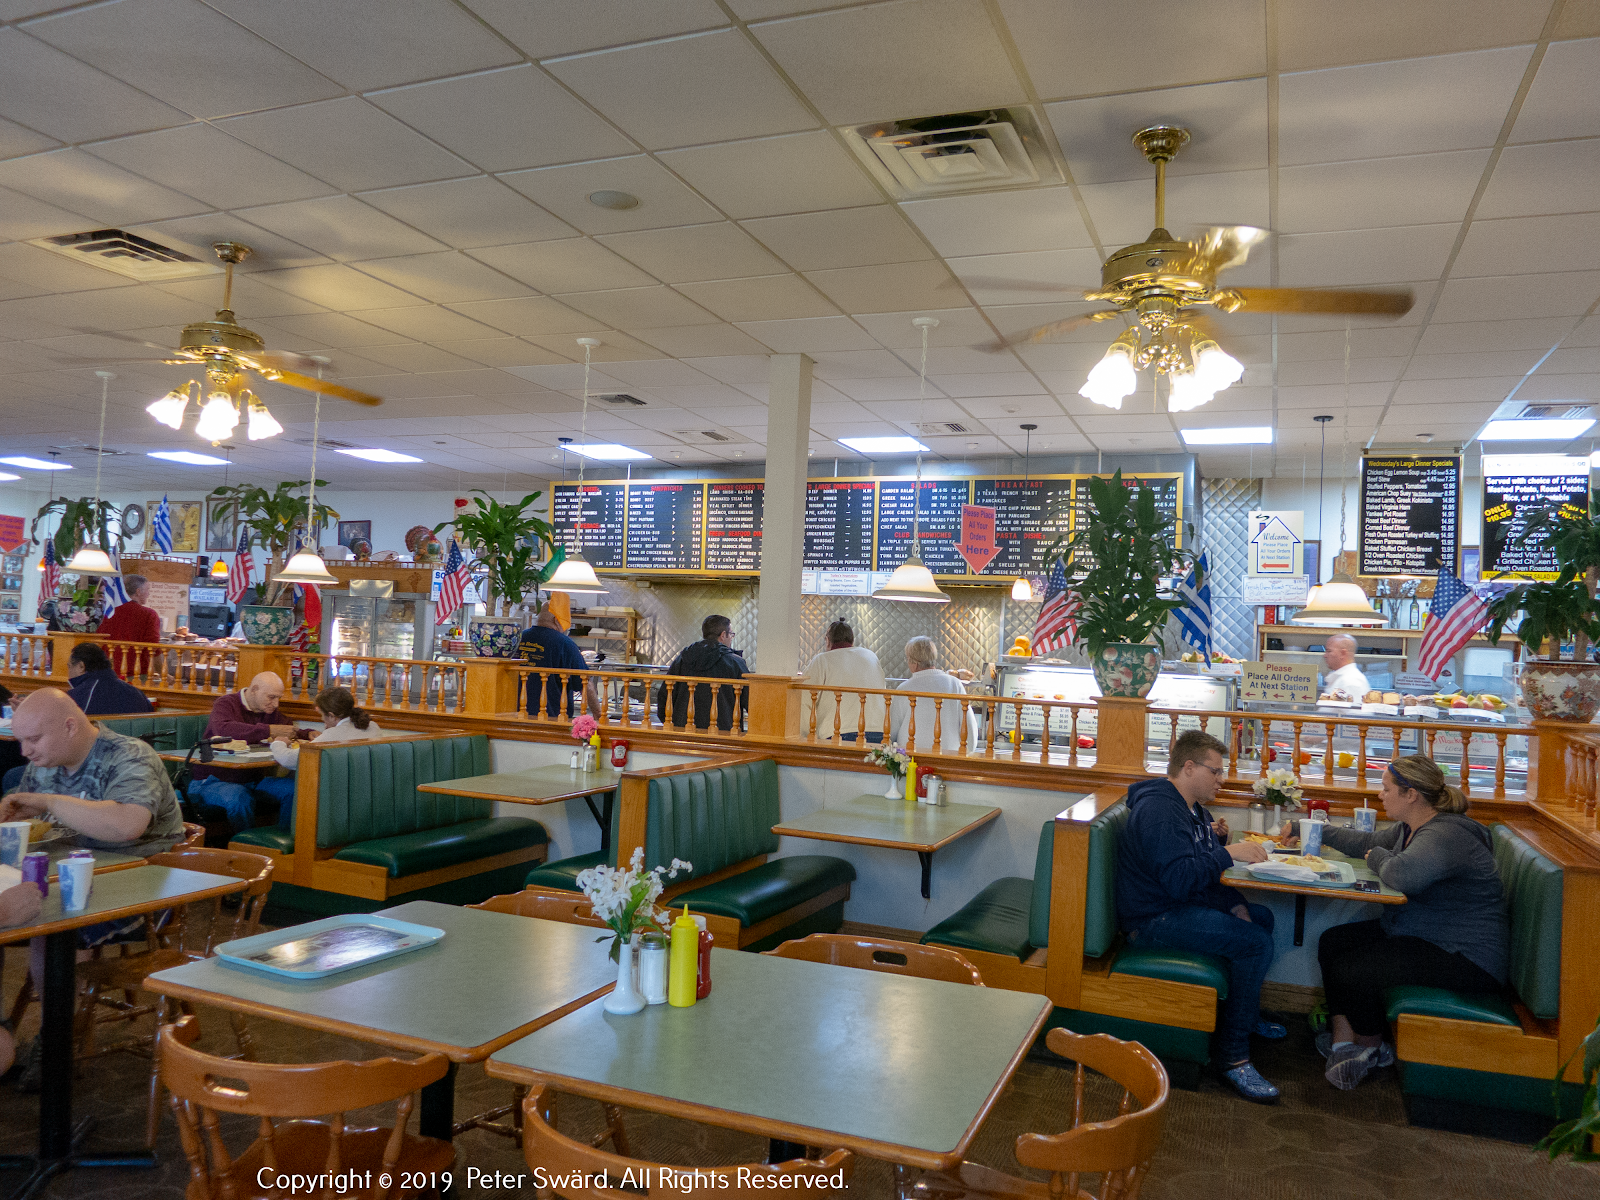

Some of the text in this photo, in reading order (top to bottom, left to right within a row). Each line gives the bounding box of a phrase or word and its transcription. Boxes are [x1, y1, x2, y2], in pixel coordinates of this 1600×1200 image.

[1514, 486, 1539, 494] Potato,
[1562, 485, 1586, 494] Potato,
[1503, 494, 1520, 502] Rice,
[964, 508, 994, 519] Please Place
[1484, 502, 1508, 516] ONLY
[1486, 510, 1512, 523] $10.95
[976, 522, 988, 530] Your
[970, 532, 986, 542] Orders
[1263, 532, 1290, 540] Welcome
[966, 544, 989, 556] Here
[1266, 664, 1292, 672] Please
[1248, 672, 1269, 680] Place
[1284, 674, 1310, 682] Orders
[1280, 682, 1308, 692] Station
